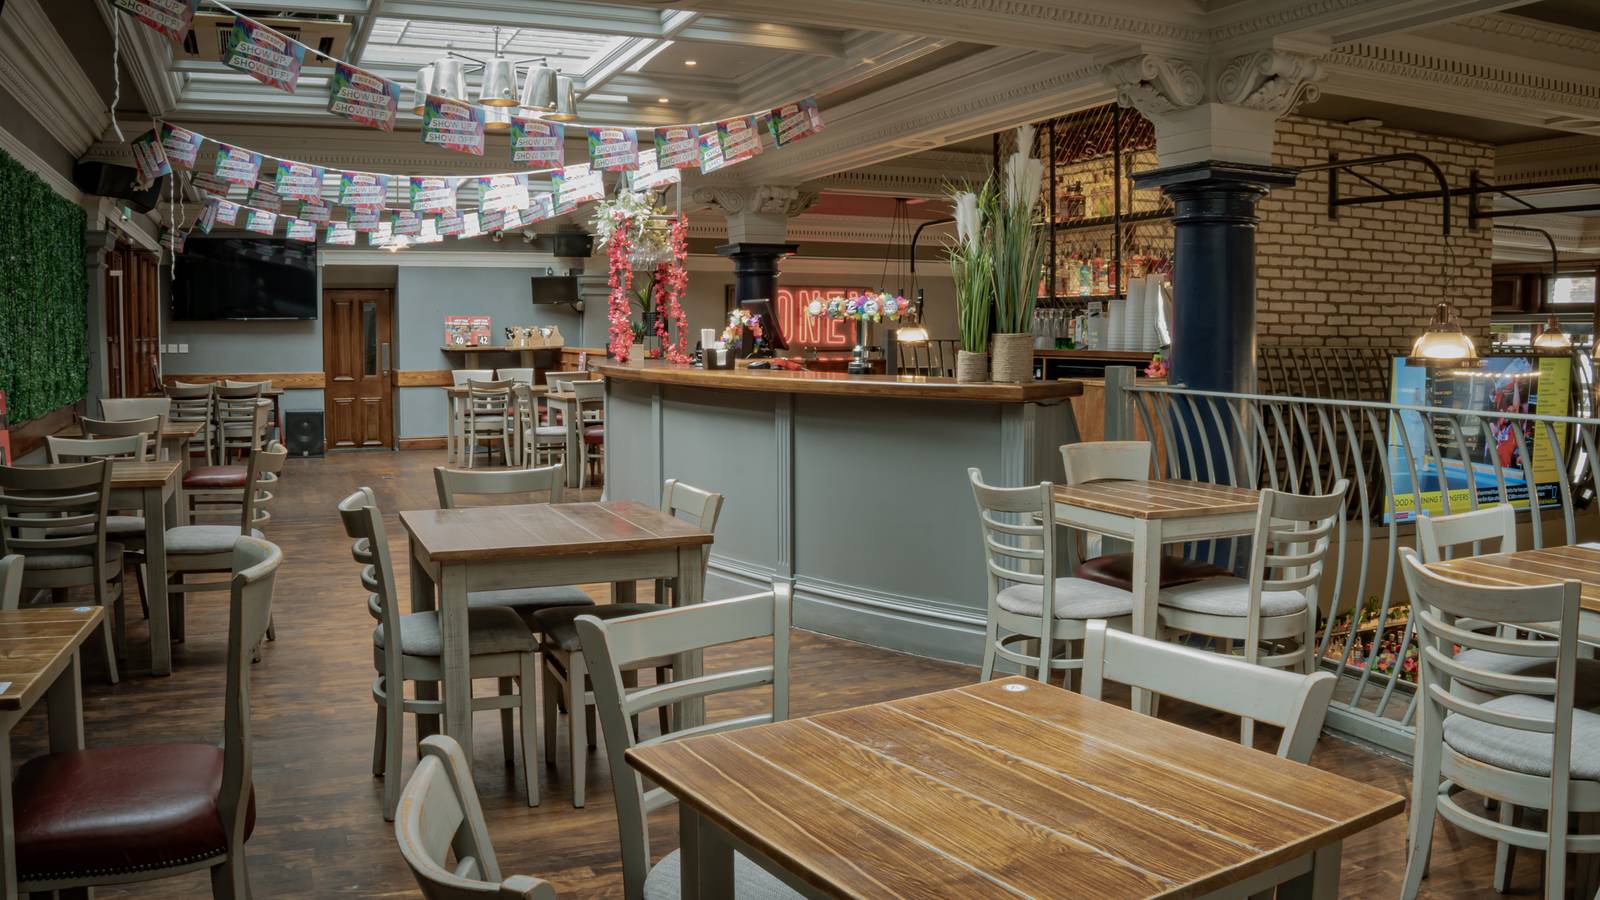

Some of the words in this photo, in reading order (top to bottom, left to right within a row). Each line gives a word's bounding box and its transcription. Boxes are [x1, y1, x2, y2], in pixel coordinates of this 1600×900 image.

[119, 0, 155, 16] SHOW
[239, 43, 272, 60] SHOW
[233, 57, 265, 72] SHOW
[341, 89, 370, 101] SHOW
[335, 102, 366, 115] SHOW
[432, 120, 458, 129] SHOW
[429, 133, 456, 142] SHOW
[518, 138, 541, 146] SHOW
[516, 152, 538, 160] SHOW
[1394, 498, 1409, 507] OOD
